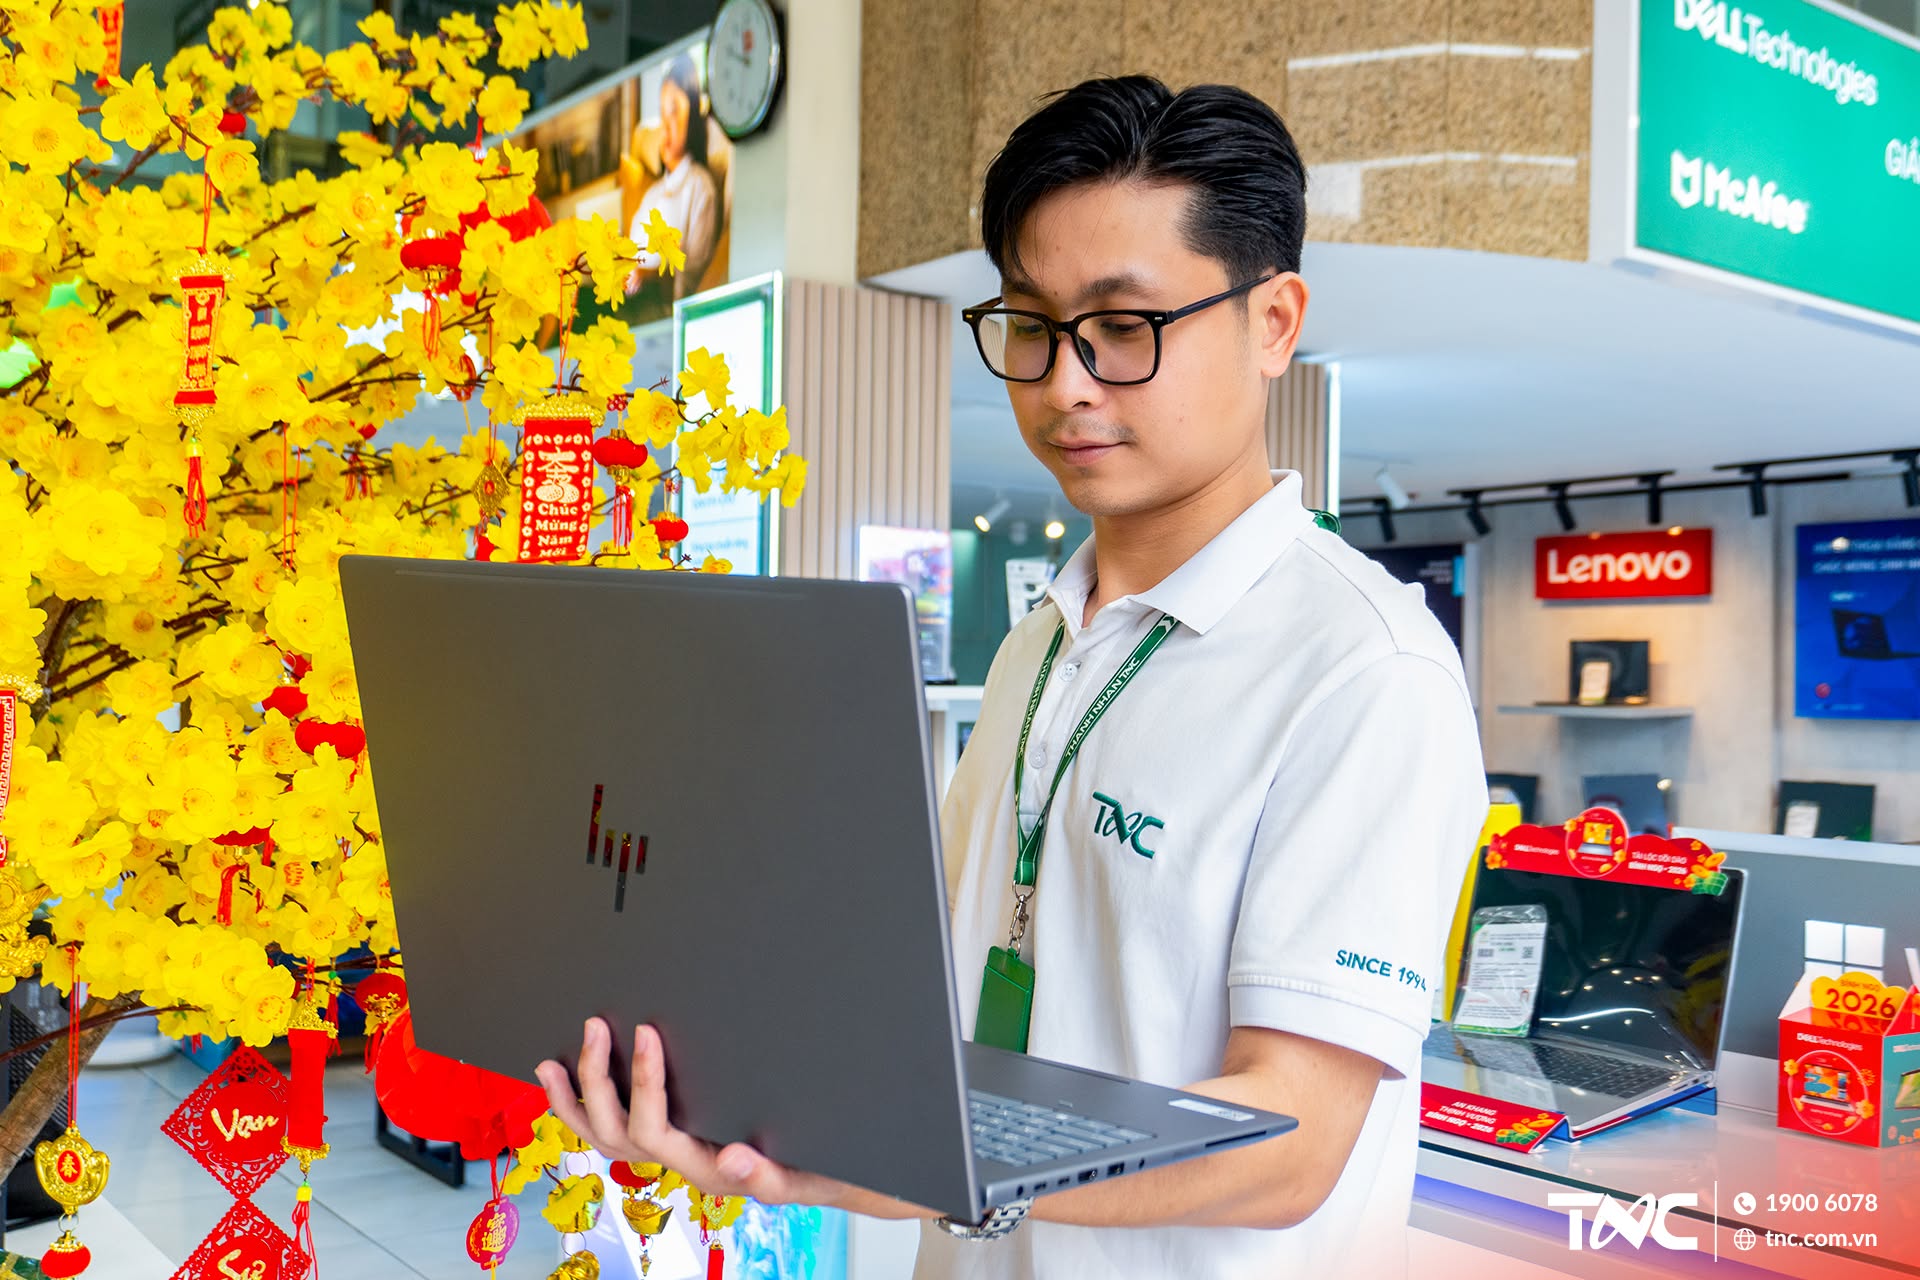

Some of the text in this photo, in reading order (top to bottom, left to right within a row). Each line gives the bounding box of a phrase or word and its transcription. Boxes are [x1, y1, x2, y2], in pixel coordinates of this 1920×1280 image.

[1703, 161, 1809, 234] McAfee
[537, 503, 579, 516] Chúc
[535, 518, 579, 533] Mừng
[537, 534, 573, 547] Năm
[1547, 548, 1692, 584] Lenovo
[1065, 657, 1140, 758] THANH NHAN TNC
[1092, 791, 1165, 859] TNC
[1335, 949, 1393, 977] SINCE
[1825, 987, 1896, 1018] 2026
[60, 1153, 78, 1178] 春
